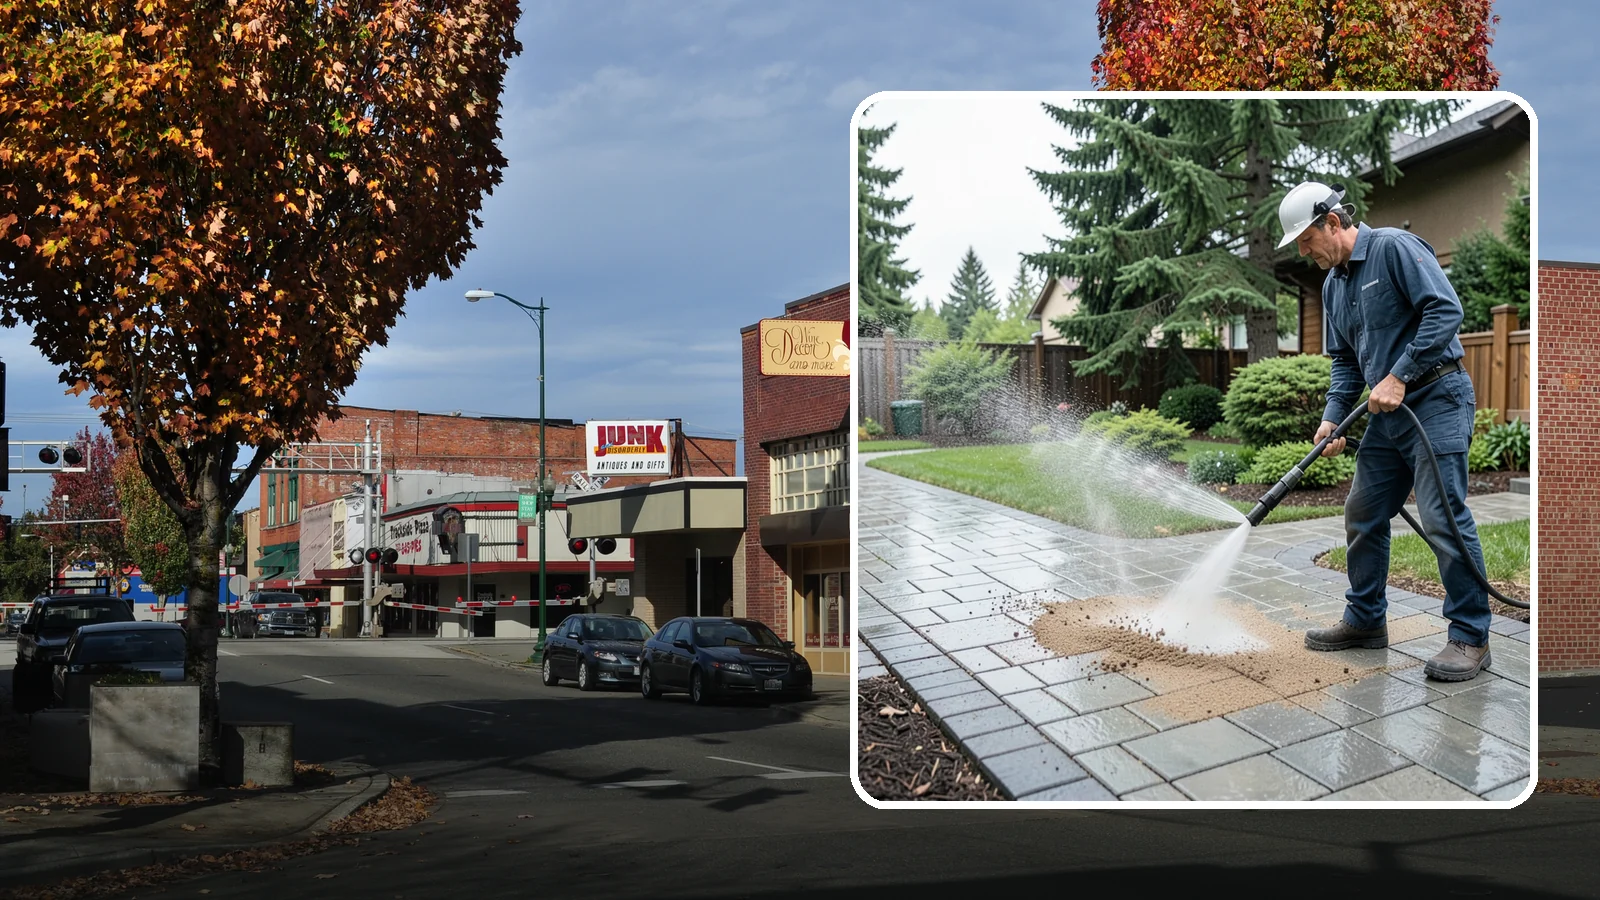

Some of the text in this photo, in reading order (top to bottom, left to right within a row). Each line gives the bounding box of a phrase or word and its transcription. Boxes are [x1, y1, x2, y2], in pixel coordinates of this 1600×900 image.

[595, 425, 665, 457] JUNK
[607, 446, 646, 454] DISORDERLY
[597, 460, 665, 470] ANTIQUES AND GIFTS
[414, 519, 429, 535] Pizza
